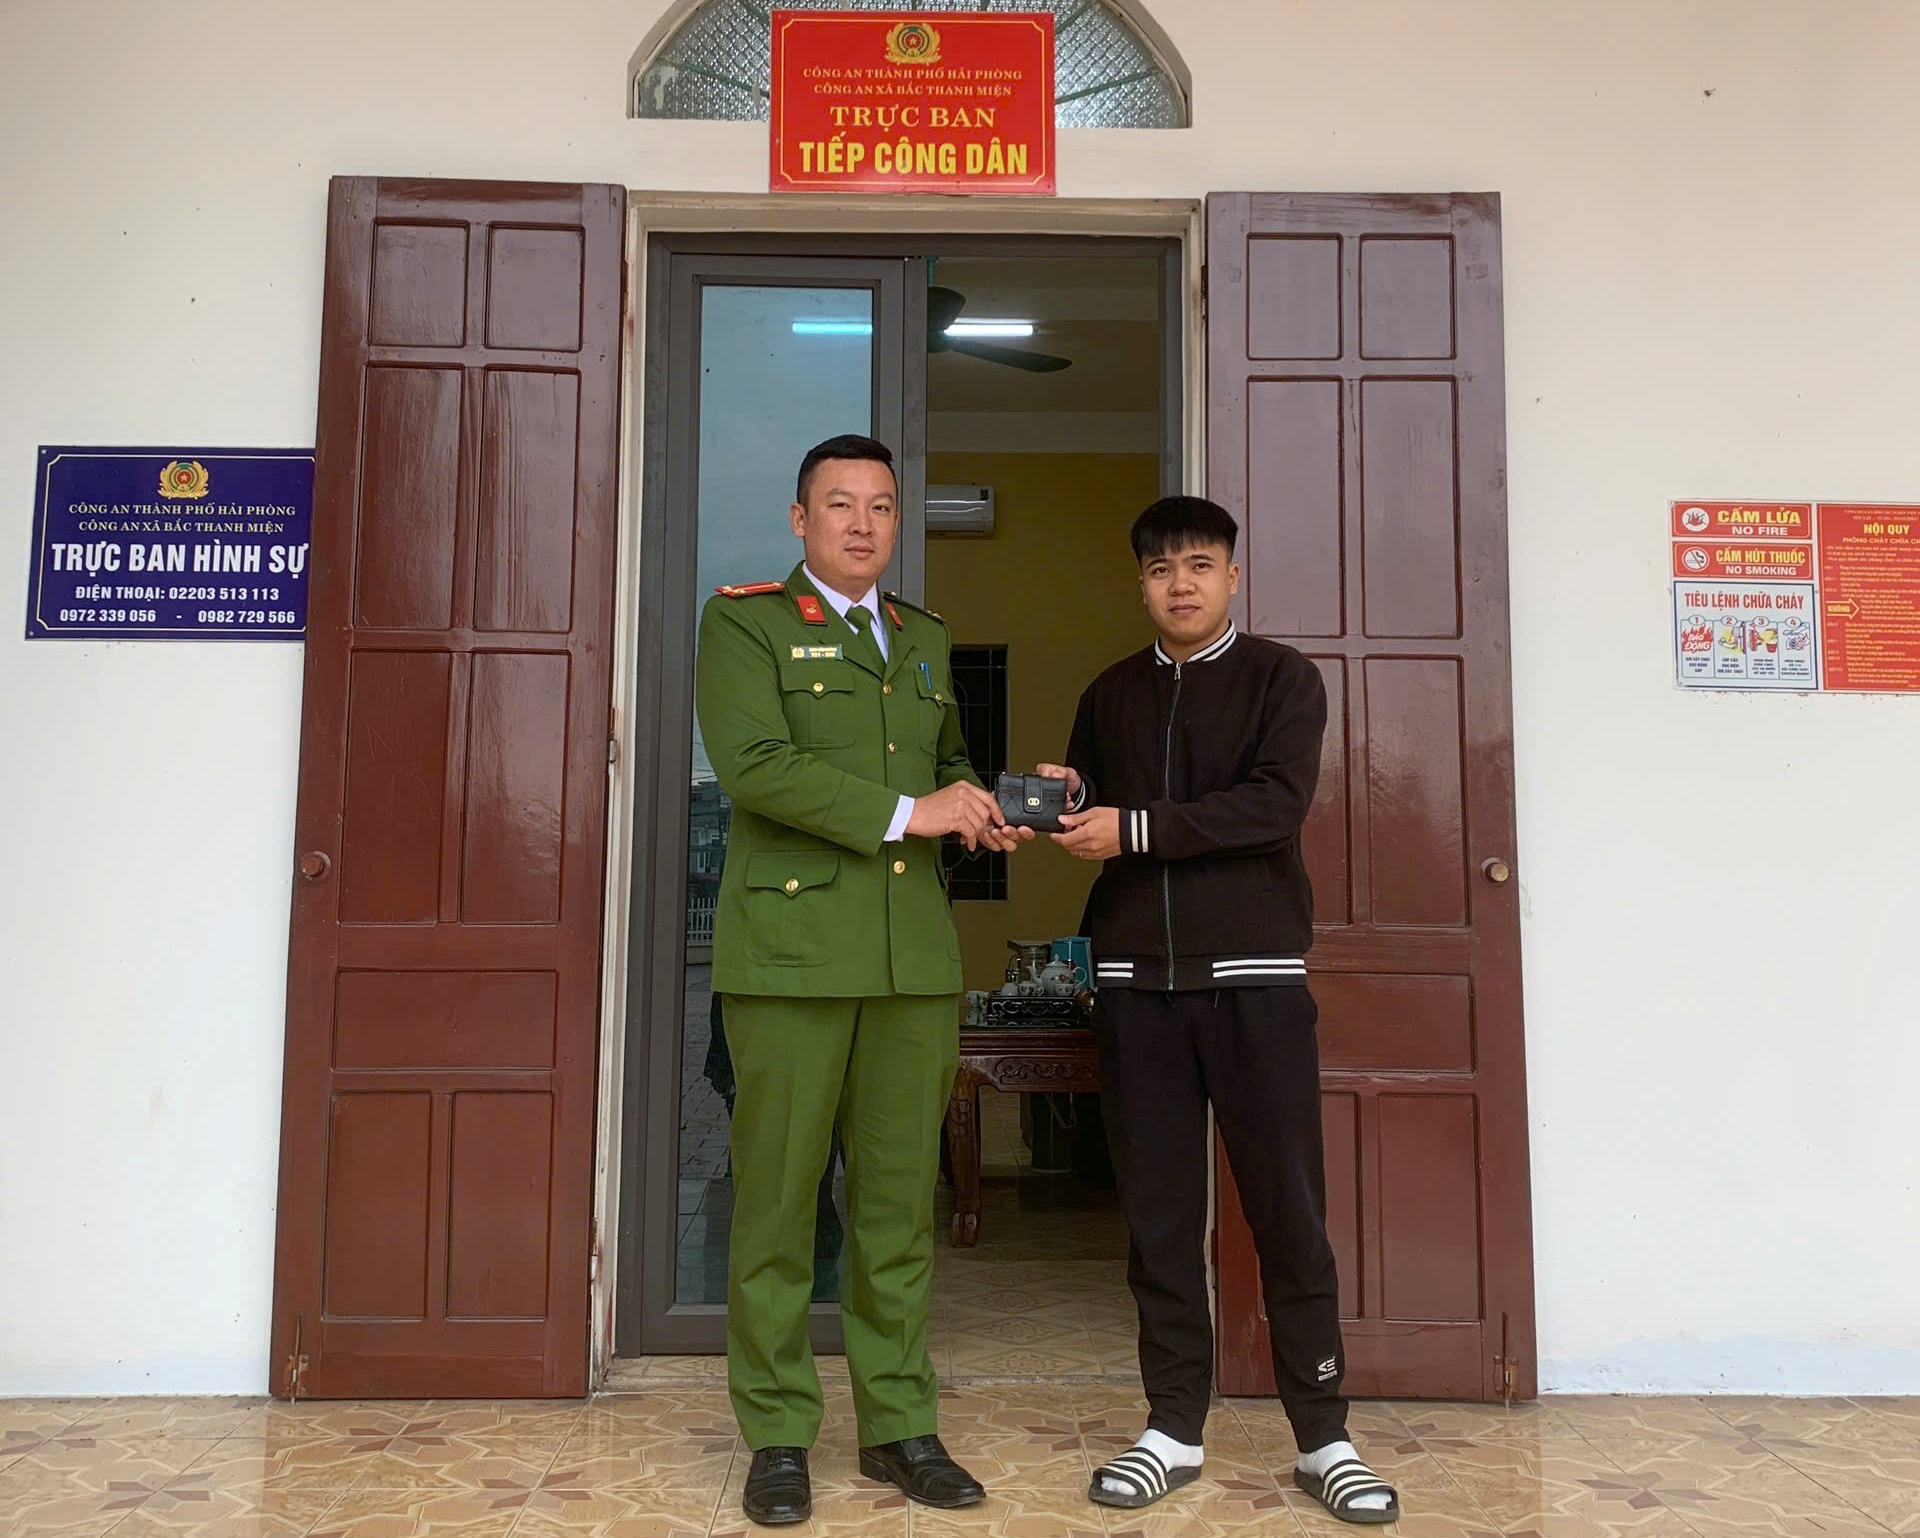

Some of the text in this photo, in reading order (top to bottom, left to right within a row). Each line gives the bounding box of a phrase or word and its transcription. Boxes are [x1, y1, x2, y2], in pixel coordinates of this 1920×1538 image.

[803, 65, 1023, 81] CÔNG AN THÀNH PHỐ HẢI PHÒNG
[814, 81, 1012, 98] CÔNG AN XÃ BẮC THANH MIỆN
[830, 104, 996, 132] TRỰC BAN
[799, 132, 1028, 175] TIẾP CÔNG DÂN
[69, 501, 296, 517] CÔNG AN THÀNH PHỐ HẢI PHÒNG
[1717, 506, 1802, 524] CẤM LỬA
[78, 518, 285, 535] CÔNG AN XÃ BẮC THANH MIỆN
[1732, 526, 1789, 536] NO FIRE
[1863, 522, 1910, 536] NỘI QUY
[51, 538, 309, 579] TRỰC BAN HÌNH SỰ
[1716, 546, 1742, 563] CẤM
[1745, 548, 1767, 563] HÚT
[1769, 547, 1806, 564] THUỐC
[1726, 565, 1797, 576] NO SMOKING
[75, 584, 280, 602] ĐIỆN THOẠI: 02203 513 113
[1712, 591, 1739, 611] LỆNH
[1743, 591, 1772, 609] CHỮA
[1776, 592, 1804, 610] CHÁY
[59, 609, 96, 623] 0972
[98, 609, 126, 623] 339
[129, 609, 157, 623] 056
[198, 610, 234, 624] 0982
[238, 610, 265, 624] 729
[268, 611, 296, 624] 566
[1694, 616, 1699, 624] 1
[1726, 617, 1733, 625] 2
[1758, 618, 1765, 626] 3
